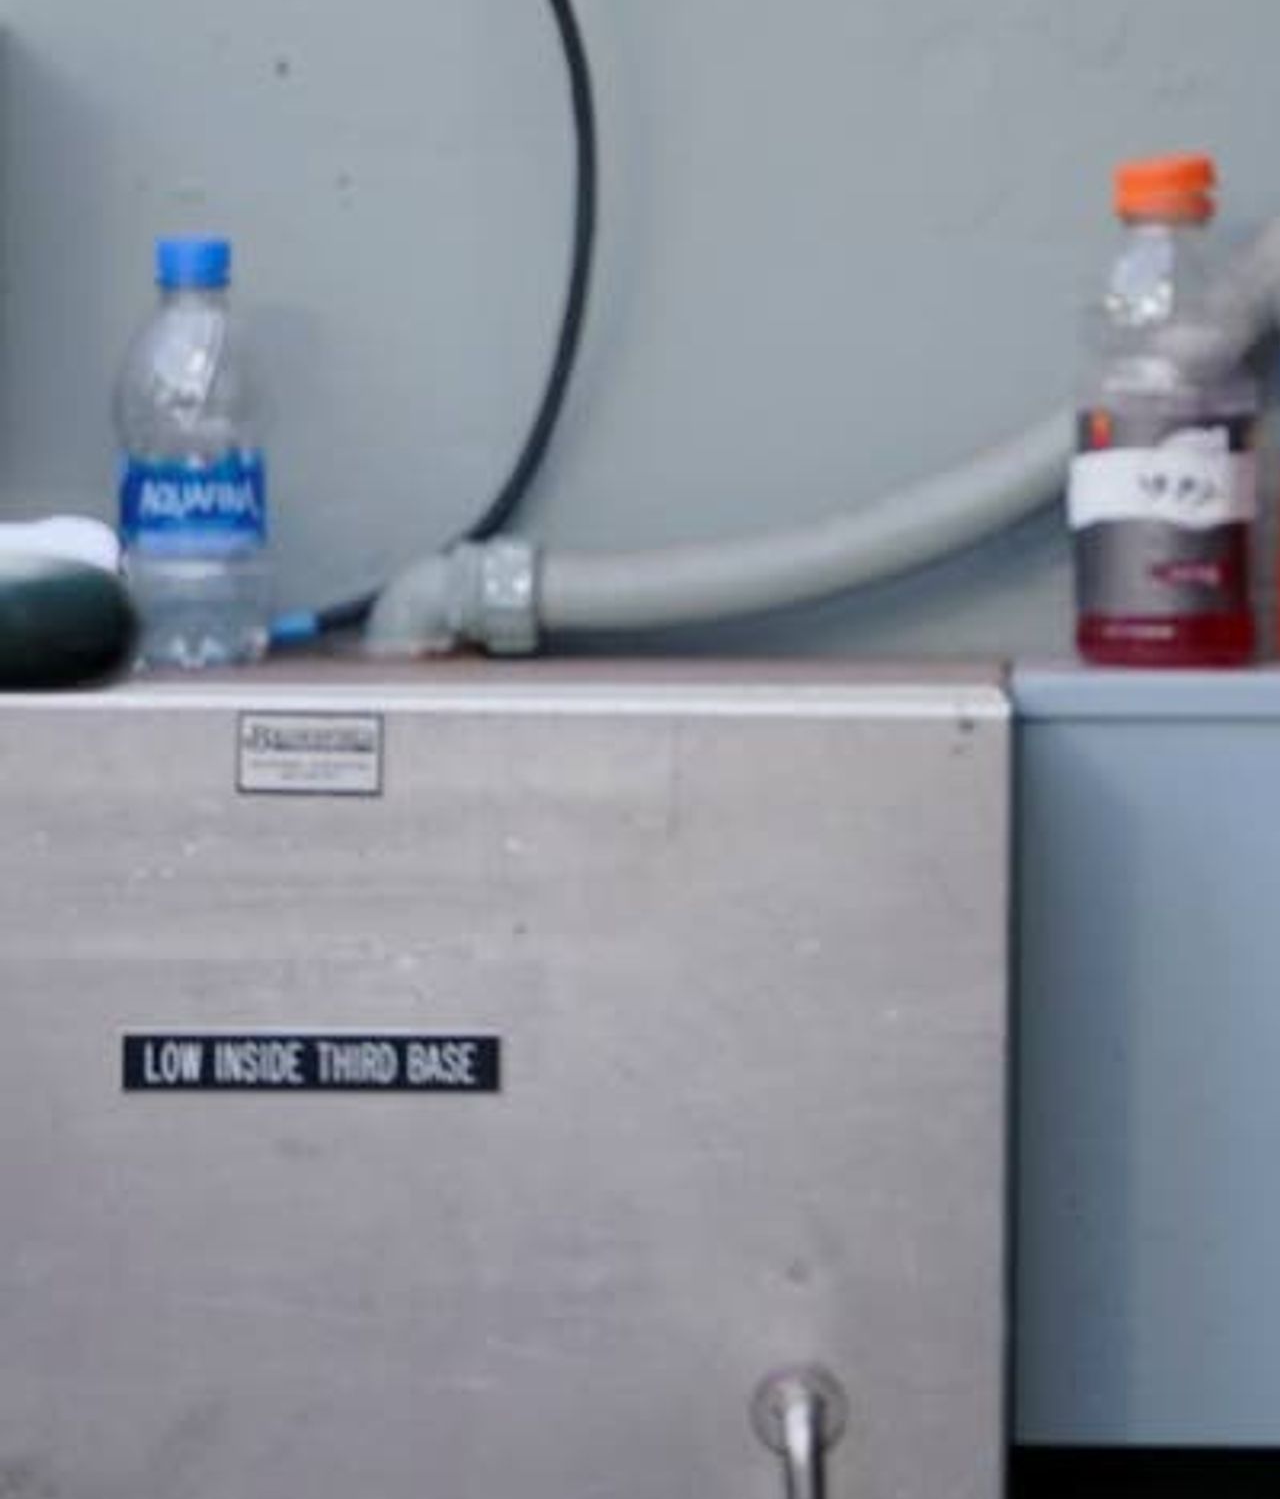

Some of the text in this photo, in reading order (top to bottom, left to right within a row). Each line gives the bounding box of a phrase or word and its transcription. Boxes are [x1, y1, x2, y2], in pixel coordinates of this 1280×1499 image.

[144, 1041, 478, 1084] LOW INSIDE THIRD BASE
